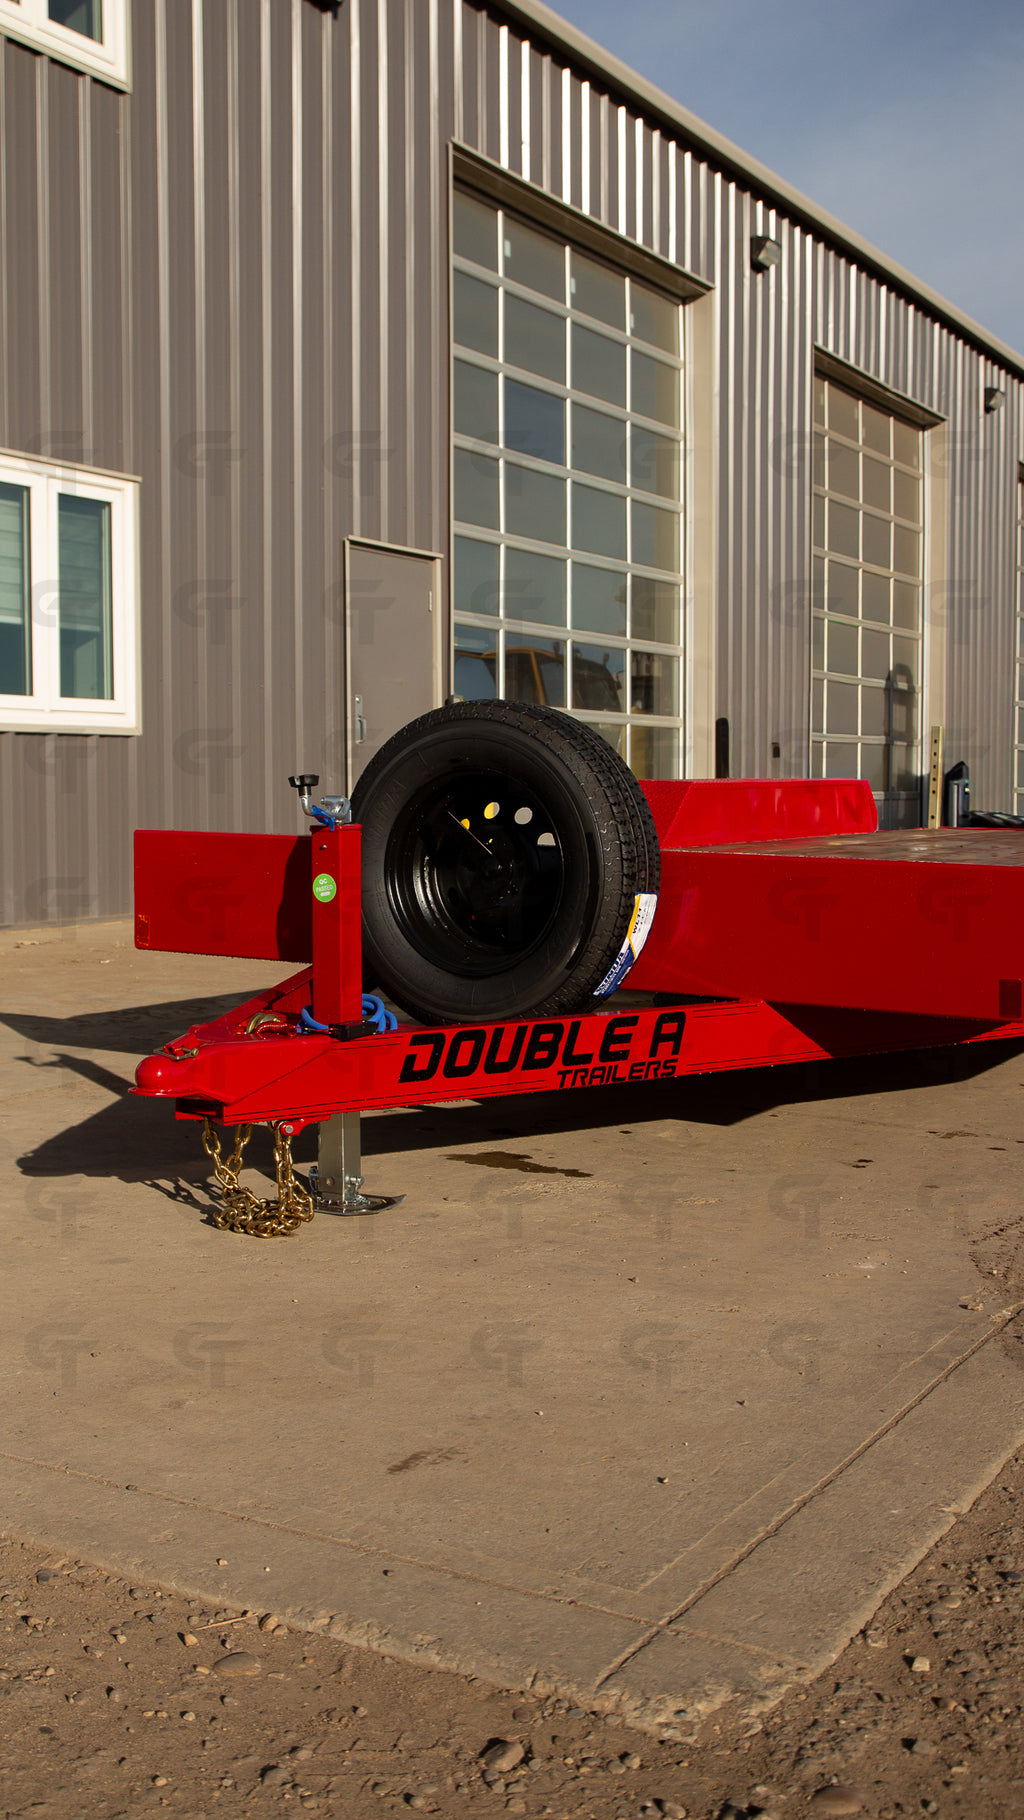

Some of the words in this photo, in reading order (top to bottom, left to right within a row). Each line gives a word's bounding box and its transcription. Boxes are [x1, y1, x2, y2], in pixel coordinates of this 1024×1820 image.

[315, 884, 334, 893] PASSED
[398, 1015, 639, 1084] DOUBLE
[649, 1011, 687, 1058] A
[557, 1058, 679, 1089] TRAILERS
